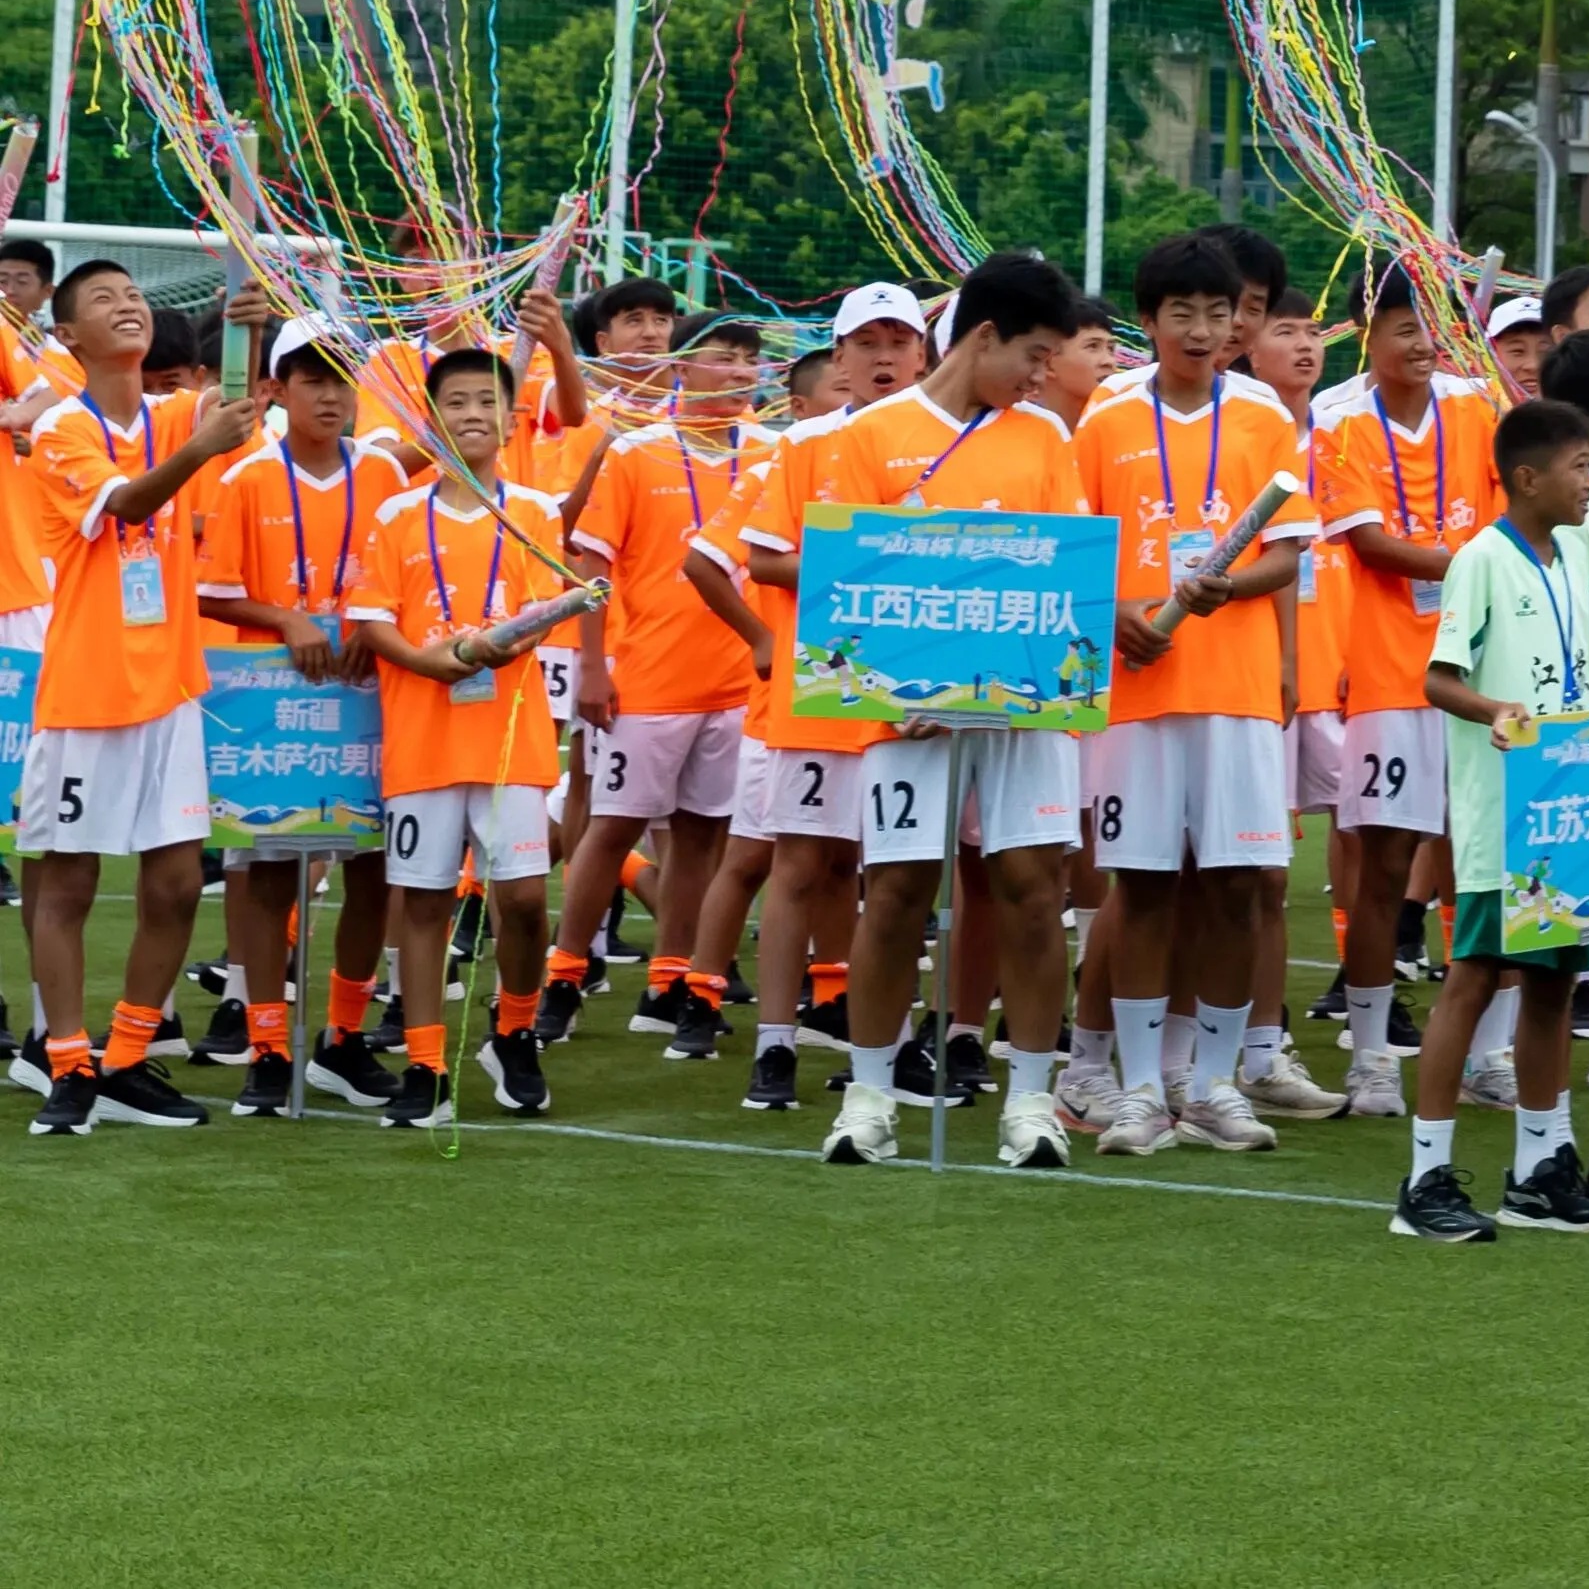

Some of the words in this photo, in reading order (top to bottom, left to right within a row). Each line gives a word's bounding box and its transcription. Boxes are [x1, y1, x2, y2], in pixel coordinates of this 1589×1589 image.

[828, 580, 1081, 638] 江西定南男队
[275, 697, 342, 733] 新疆
[606, 751, 628, 792] 3
[800, 761, 824, 807] 2
[1361, 753, 1407, 801] 29
[58, 777, 84, 824] 5
[871, 780, 918, 832] 12
[387, 813, 420, 860] 10
